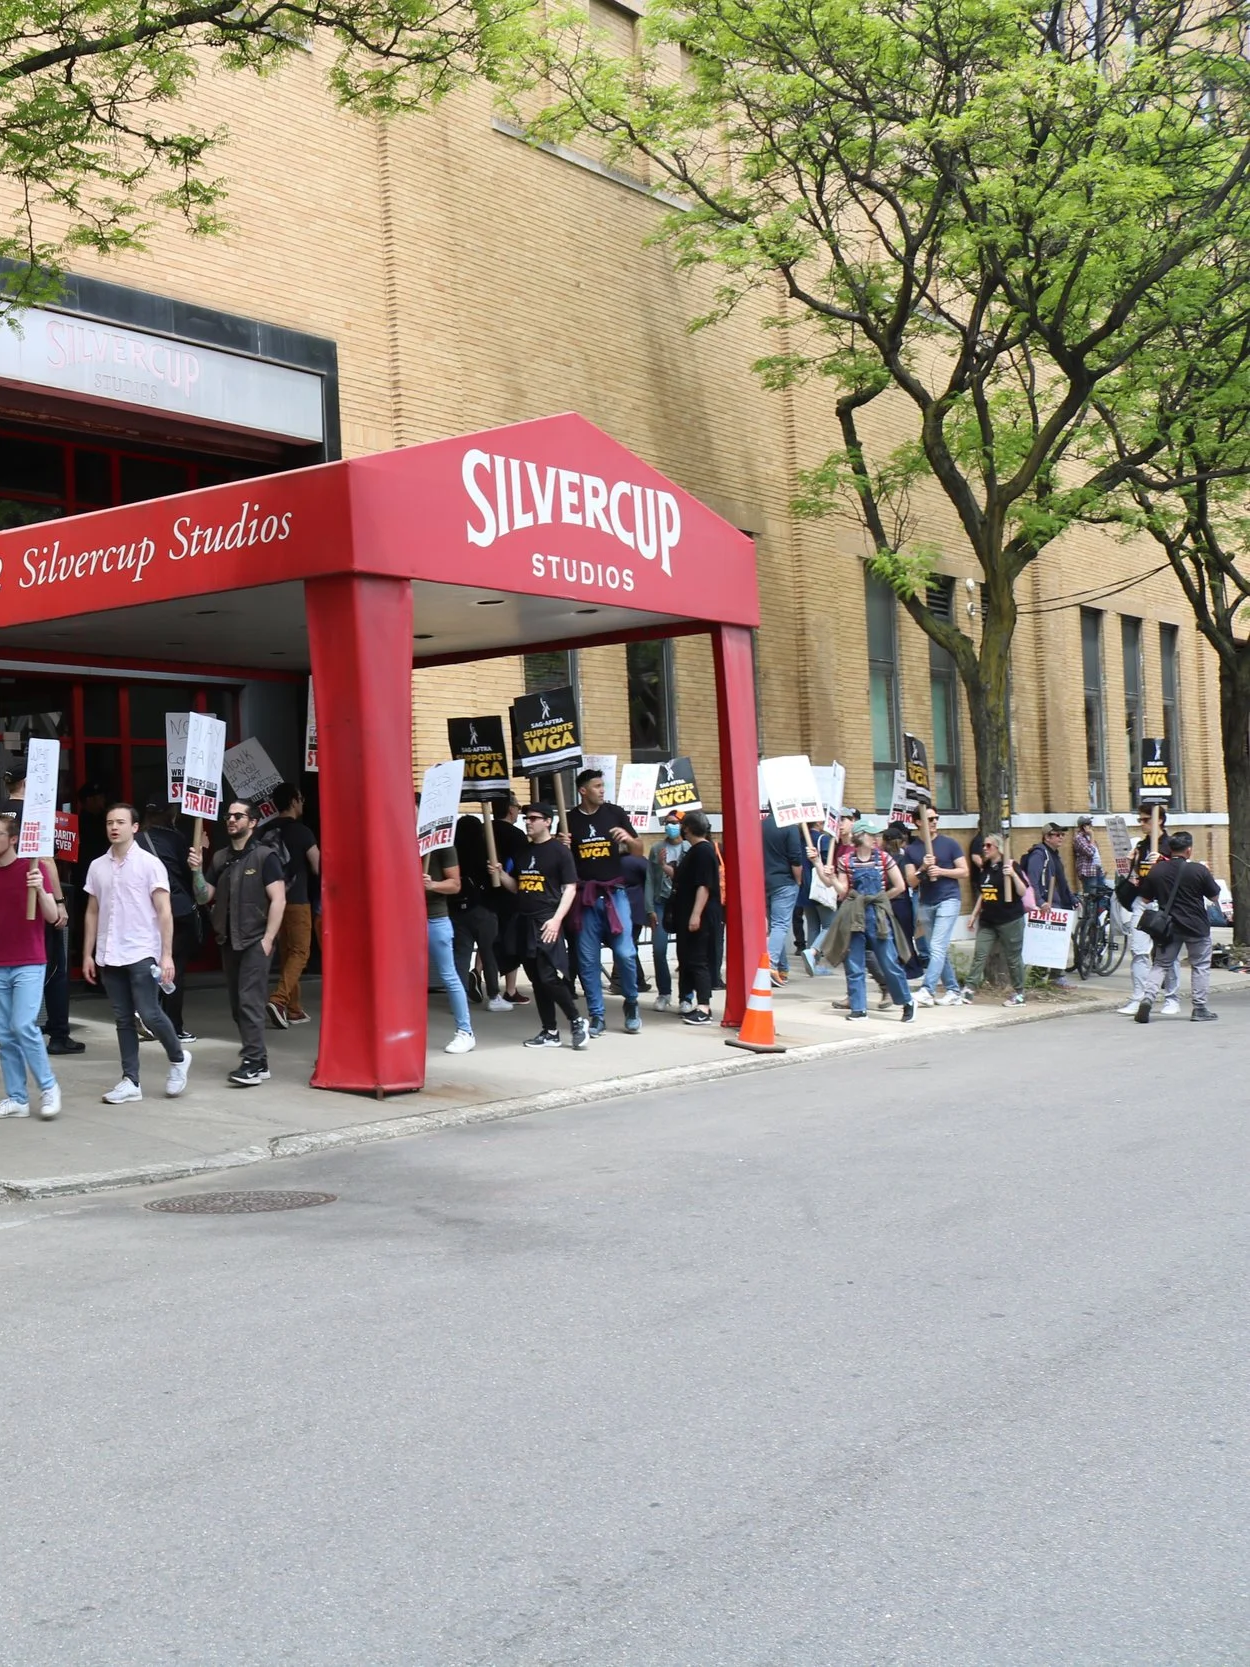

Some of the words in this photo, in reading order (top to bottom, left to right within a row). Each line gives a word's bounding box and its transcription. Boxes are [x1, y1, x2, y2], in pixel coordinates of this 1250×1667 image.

[46, 320, 200, 398] SILVERCUP
[94, 373, 159, 400] STUDIOS
[462, 448, 682, 577] SILVERCUP
[19, 536, 156, 588] Silvercup
[169, 501, 293, 560] Studios
[532, 553, 634, 591] STUDIOS
[523, 722, 574, 739] SUPPORTS
[524, 733, 575, 753] WGA
[655, 783, 694, 797] SUPPORTS
[655, 790, 696, 807] WGA
[185, 792, 216, 814] STRIKE!
[55, 829, 76, 841] DARITY
[56, 840, 72, 851] EVER
[579, 847, 610, 858] WGA
[982, 893, 997, 901] GA
